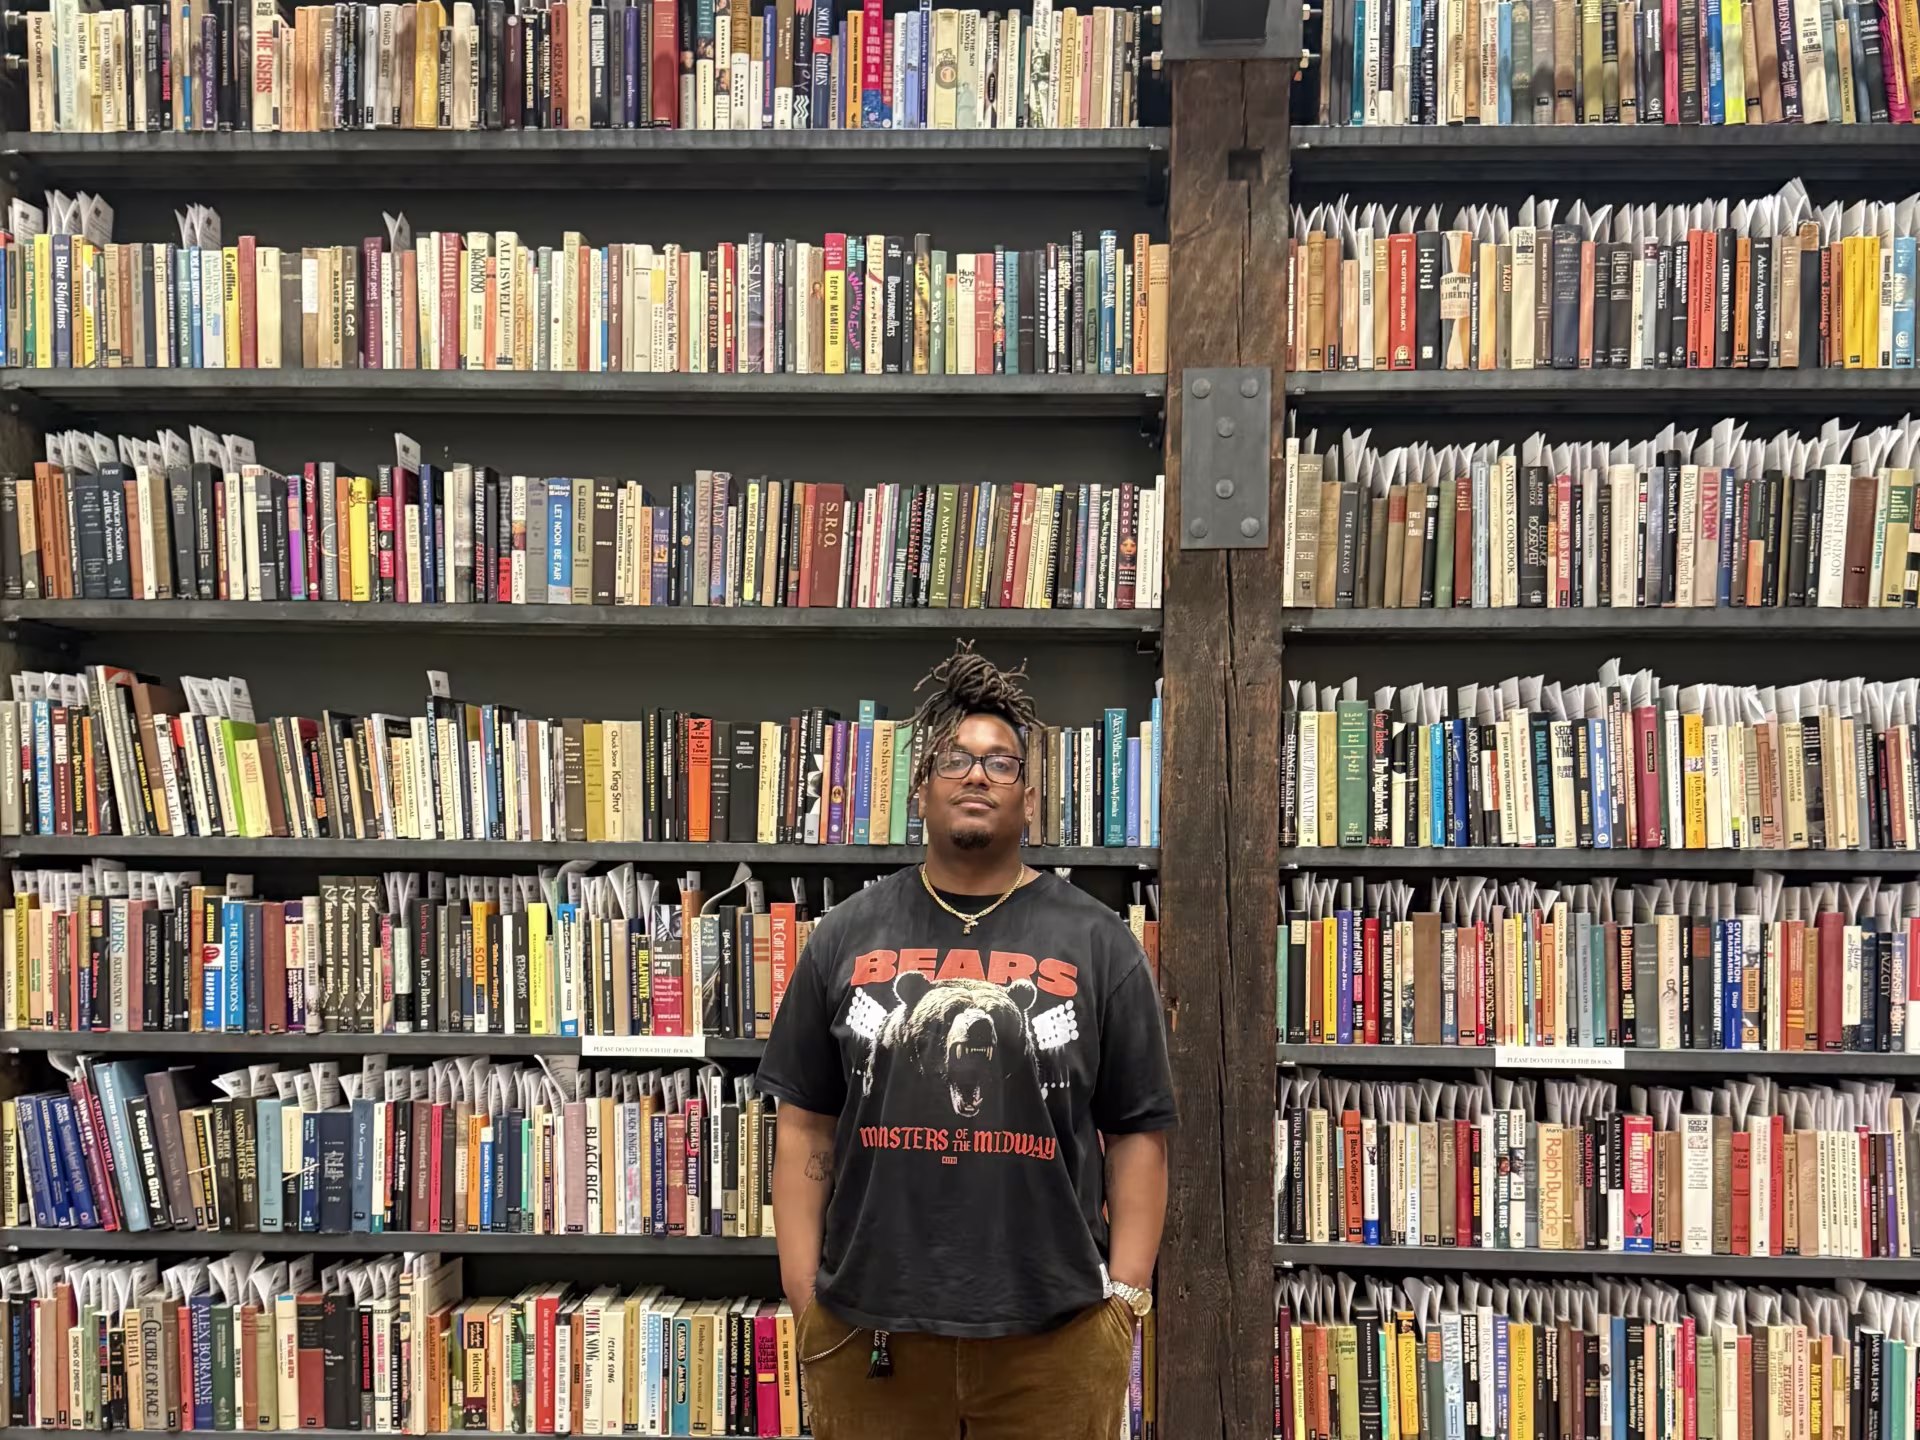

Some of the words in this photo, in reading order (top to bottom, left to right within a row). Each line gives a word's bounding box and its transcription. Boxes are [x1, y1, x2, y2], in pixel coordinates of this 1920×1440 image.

[34, 17, 44, 40] Bright
[591, 15, 604, 39] BEYOND
[816, 8, 829, 36] SOCIAL
[79, 35, 87, 51] Straw
[256, 30, 272, 50] THE
[1370, 38, 1377, 54] La
[35, 41, 44, 78] Continent
[79, 53, 87, 69] Man
[592, 41, 604, 66] RACISM
[1065, 38, 1074, 93] Corregidora
[256, 55, 272, 93] USERS
[816, 54, 829, 85] CRIMES
[1368, 57, 1377, 87] Toya
[500, 240, 510, 266] ALL
[56, 256, 68, 280] Blue
[225, 253, 236, 301] Cotillion
[471, 248, 486, 293] BAGAMOYO
[500, 268, 510, 278] IS
[1502, 265, 1512, 292] YAZOO
[1758, 255, 1767, 280] Advice
[368, 282, 377, 300] poet
[748, 264, 760, 302] SLAVE
[829, 275, 839, 301] Terry
[1755, 281, 1767, 309] Among
[55, 282, 69, 329] Rhythms
[345, 281, 354, 312] LETHAL
[500, 281, 510, 317] WELL
[345, 314, 354, 336] GAS
[830, 305, 840, 345] McMillan
[1757, 310, 1767, 339] Masters
[475, 471, 484, 501] WALTER
[1506, 464, 1515, 515] ANTOINE'S
[1683, 473, 1694, 487] Bob
[103, 490, 112, 506] and
[112, 490, 122, 525] American
[1681, 490, 1693, 532] Woodward
[105, 508, 113, 527] Black
[475, 504, 484, 534] MOSLEY
[554, 504, 562, 520] LET
[748, 503, 756, 526] WHEN
[824, 502, 837, 547] S.R.O.
[105, 528, 114, 564] Americans
[114, 527, 123, 561] Socialism
[554, 522, 562, 547] NOON
[747, 529, 755, 555] ROCKS
[1507, 518, 1515, 574] COOKBOOK
[1528, 517, 1540, 566] ROOSEVELT
[1539, 525, 1547, 566] ELEANOR
[1681, 537, 1691, 551] The
[475, 541, 484, 560] FEAR
[554, 549, 562, 561] BE
[475, 562, 484, 591] ITSELF
[554, 563, 562, 580] FAIR
[746, 557, 754, 584] DANCE
[1679, 554, 1691, 585] Agenda
[1112, 714, 1123, 732] Alice
[1373, 713, 1388, 726] Gay
[610, 731, 618, 748] Chuck
[882, 727, 891, 748] The
[1111, 734, 1124, 758] Walker
[1375, 729, 1390, 753] Talese
[882, 751, 890, 776] Slave
[1374, 758, 1388, 773] Thy
[39, 772, 49, 783] THE
[610, 771, 621, 787] King
[38, 784, 51, 813] APOLLO
[611, 791, 621, 813] Strut
[879, 779, 889, 814] Stealer
[1374, 774, 1389, 813] Neighbor's
[1375, 815, 1388, 831] Wife
[362, 903, 370, 921] Black
[420, 903, 429, 929] Andrew
[111, 905, 125, 953] LEADERS
[230, 923, 238, 939] THE
[362, 923, 370, 956] Defenders
[1382, 930, 1393, 945] THE
[1622, 929, 1633, 946] BAD
[1727, 922, 1733, 933] OR
[419, 931, 429, 954] Young
[230, 940, 238, 973] UNITED
[363, 958, 371, 966] of
[420, 957, 430, 968] An
[475, 947, 485, 982] SOUL
[1383, 948, 1393, 979] MAKING
[1622, 948, 1633, 990] INTENTIONS
[363, 967, 371, 994] America
[419, 970, 430, 986] Easy
[639, 950, 648, 998] BELAFONTE
[851, 948, 1078, 997] BEARS
[1384, 981, 1392, 990] OF
[230, 974, 238, 1011] NATIONS
[420, 988, 430, 1016] Burden
[1384, 1000, 1392, 1017] MAN
[136, 1110, 150, 1149] Forced
[689, 1105, 699, 1152] DEMOCRACY
[956, 1128, 968, 1140] OF
[1499, 1114, 1508, 1135] CATCH
[585, 1127, 598, 1169] BLACK
[952, 1140, 971, 1152] THE
[974, 1130, 1057, 1160] MIDWAY
[1499, 1138, 1508, 1154] THIS!
[1545, 1137, 1560, 1178] Ralph
[143, 1153, 157, 1175] Into
[1293, 1140, 1302, 1178] BLESSED
[586, 1174, 598, 1204] RICE
[688, 1158, 696, 1195] REMIXED
[1498, 1176, 1508, 1202] TERRELL
[146, 1178, 162, 1209] Glory
[1499, 1204, 1508, 1228] OWENS
[1546, 1182, 1561, 1237] Bunche
[145, 1307, 154, 1318] THE
[199, 1304, 211, 1338] ALEX
[585, 1309, 600, 1336] !CLICK
[126, 1318, 138, 1367] LIBERIA
[1497, 1321, 1507, 1338] LONG
[143, 1320, 161, 1370] CRUCIBLE
[585, 1339, 600, 1360] SONG
[1497, 1343, 1507, 1358] TIME
[145, 1373, 158, 1386] OF
[199, 1342, 212, 1404] BORAINE
[472, 1353, 482, 1392] identities
[1497, 1362, 1506, 1388] COMING
[1811, 1364, 1820, 1372] An
[1812, 1375, 1821, 1398] African
[146, 1389, 159, 1417] RACE
[1812, 1400, 1821, 1433] Meditation
